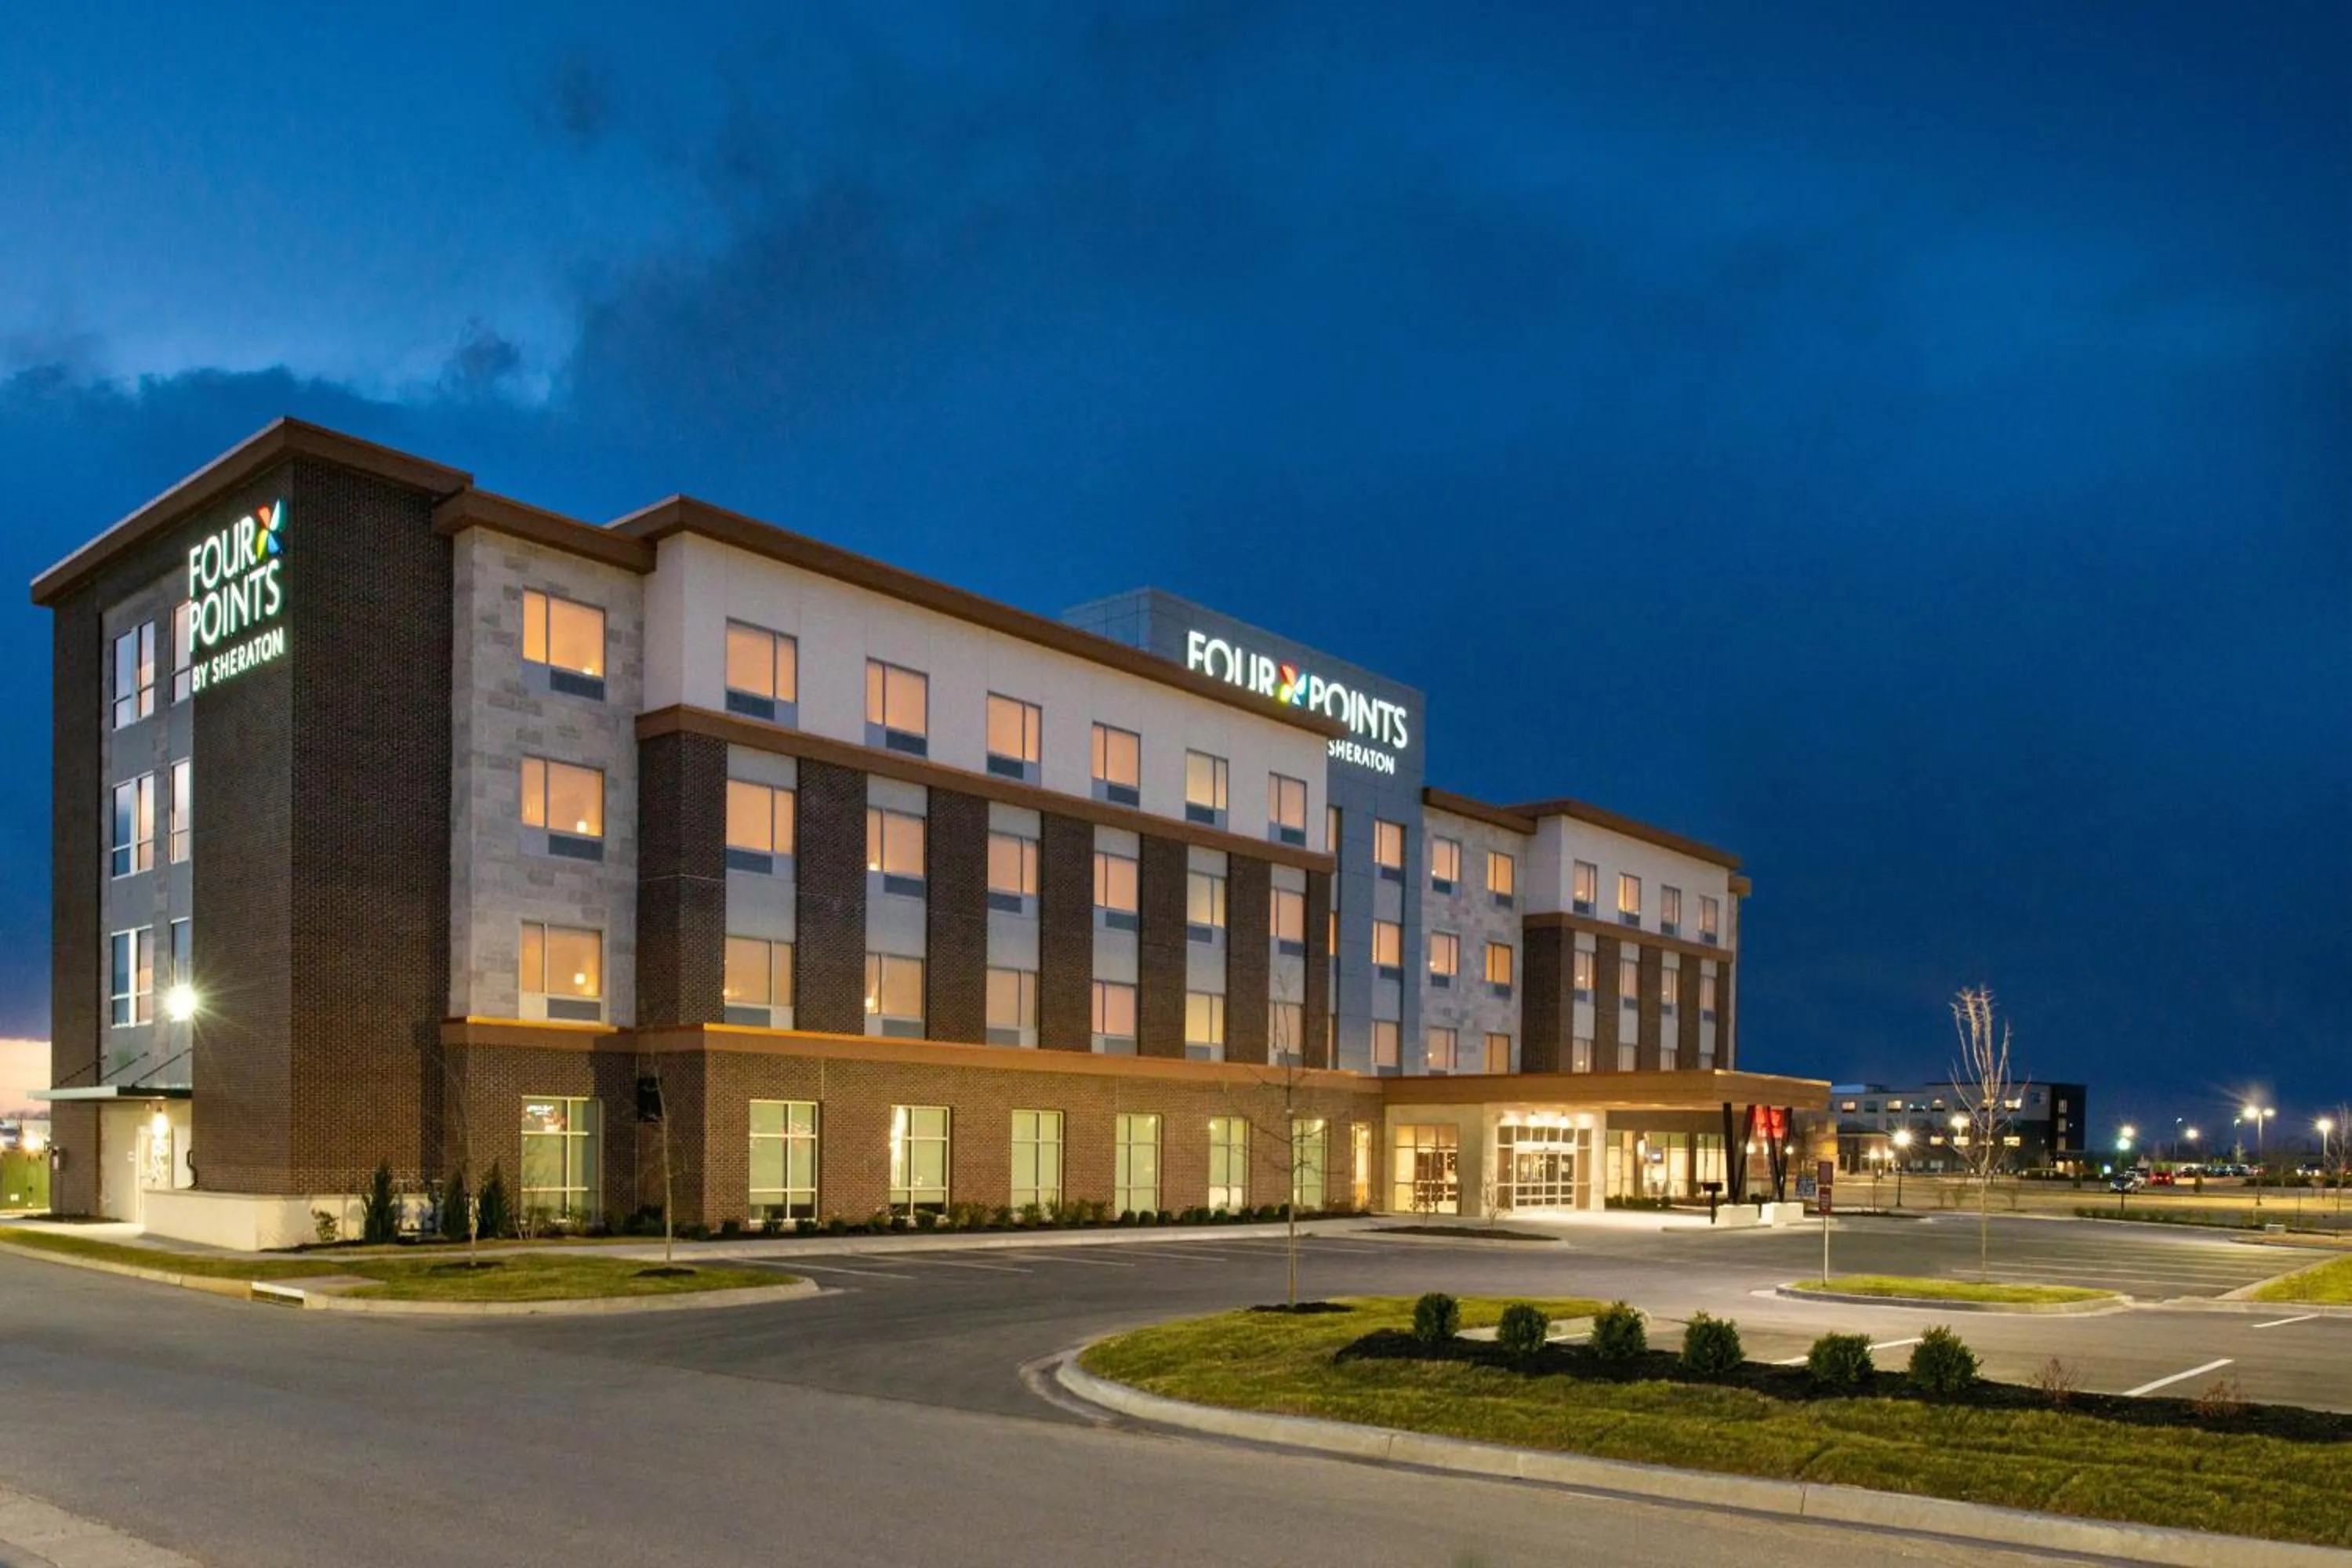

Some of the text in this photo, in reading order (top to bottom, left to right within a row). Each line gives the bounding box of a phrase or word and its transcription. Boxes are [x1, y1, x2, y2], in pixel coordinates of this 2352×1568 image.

[189, 516, 256, 598] FOUR
[189, 559, 281, 653] POINTS
[192, 627, 283, 692] BY SHERATON
[1188, 630, 1408, 749] FOUR POINTS
[1328, 739, 1395, 775] SHERATON
